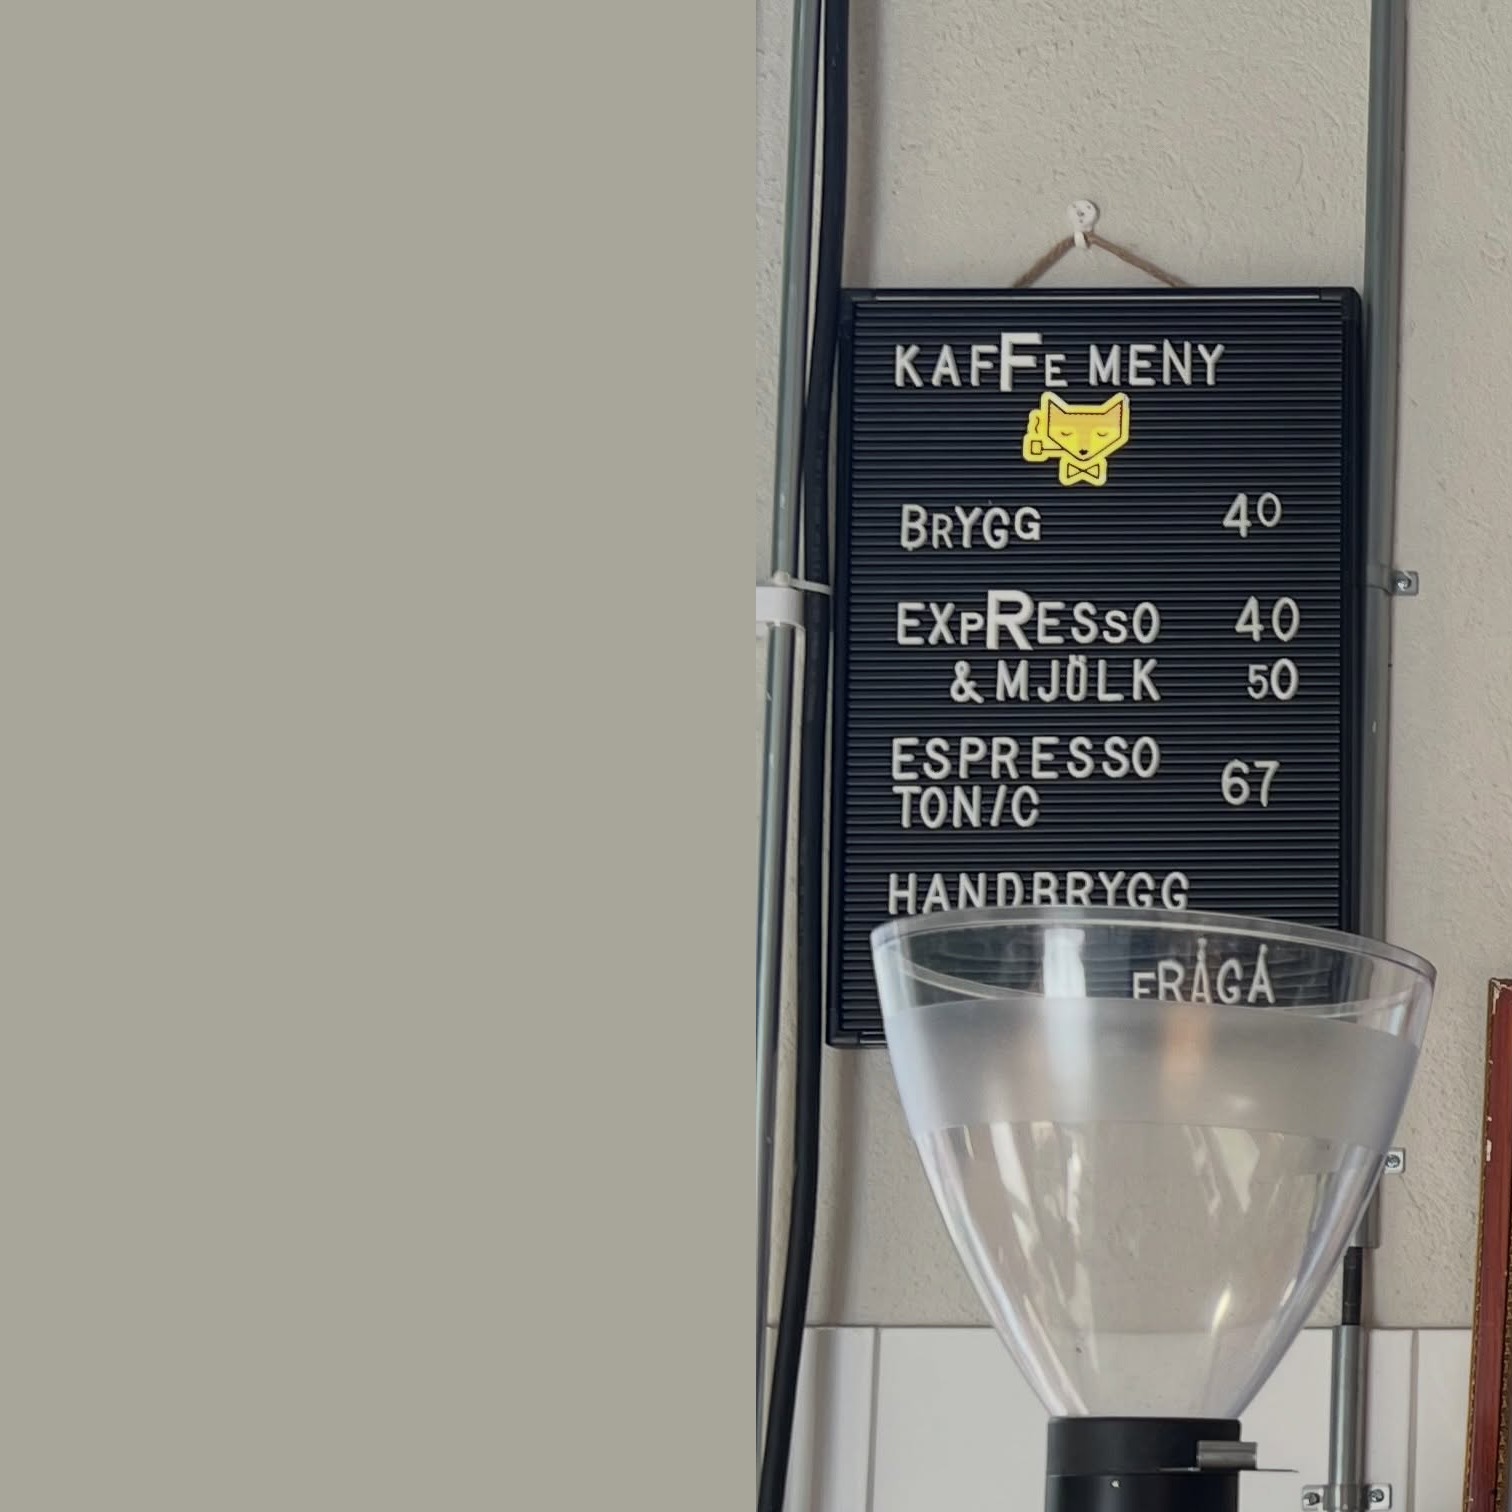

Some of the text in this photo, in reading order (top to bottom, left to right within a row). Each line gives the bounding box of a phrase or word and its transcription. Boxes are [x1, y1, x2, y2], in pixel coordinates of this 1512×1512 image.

[894, 332, 1226, 391] KAFFE MENY
[900, 492, 1281, 551] BRYGG 40
[895, 589, 1300, 651] EXPRESSO 40
[949, 654, 1299, 703] & MJÖLK 50
[891, 736, 1160, 780] ESPRESSO
[1220, 759, 1280, 808] 67
[887, 870, 1190, 915] HANDBRYGG
